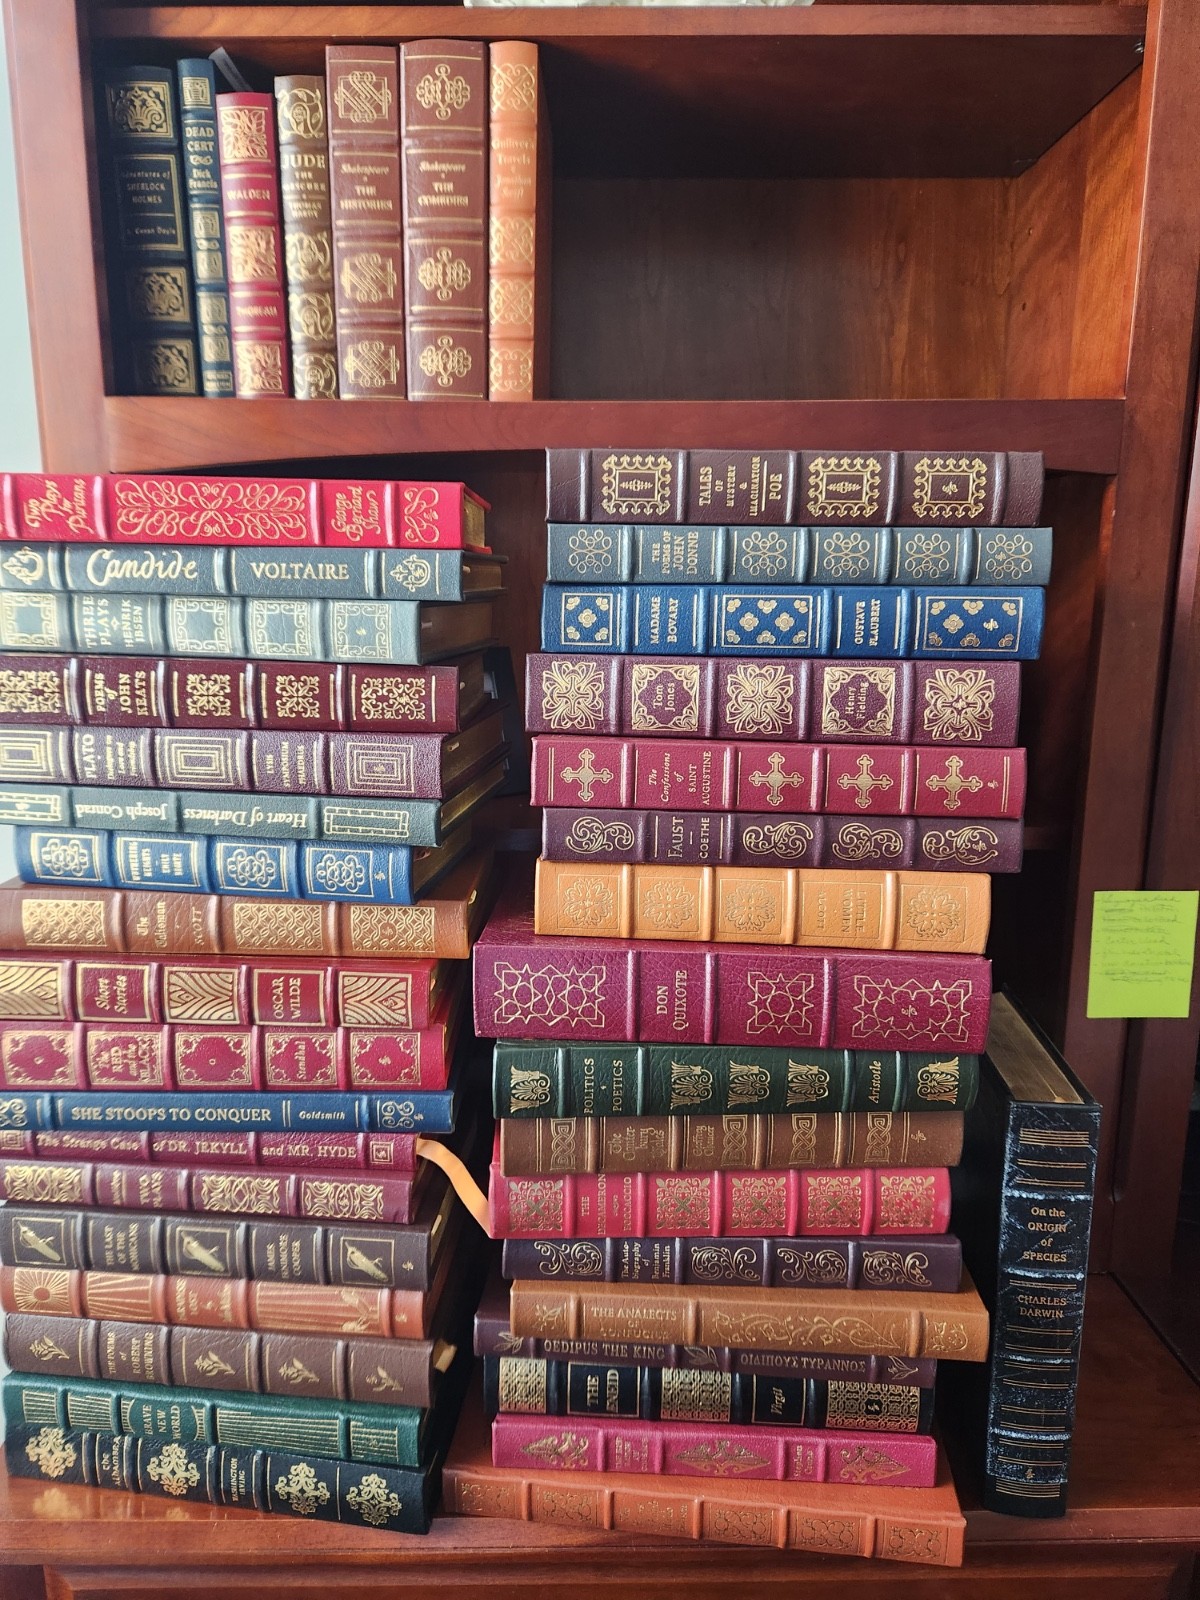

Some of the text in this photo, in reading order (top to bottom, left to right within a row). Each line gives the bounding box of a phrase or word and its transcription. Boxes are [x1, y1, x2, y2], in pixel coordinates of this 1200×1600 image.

[185, 127, 214, 138] DEAD
[187, 141, 214, 152] CERT
[281, 154, 326, 170] JUDE
[340, 163, 390, 176] Shakespeare
[419, 161, 466, 173] Shakespeare
[226, 189, 271, 201] WALDEN
[698, 466, 713, 507] TALES
[714, 479, 724, 492] OF
[726, 465, 737, 507] MYSTERY
[749, 456, 760, 517] IMAGINATION
[768, 472, 783, 501] POE
[86, 548, 198, 586] Candide
[652, 543, 660, 563] THE
[662, 544, 671, 575] POEMS
[673, 535, 684, 571] JOHN
[687, 531, 698, 575] DONNE
[250, 562, 350, 580] VOLTAIRE
[82, 595, 95, 649] THREE
[96, 598, 111, 646] PLAYS
[121, 599, 134, 648] HENRIK
[132, 605, 146, 643] IBSEN
[650, 596, 660, 645] MADAME
[667, 597, 678, 643] BOVARY
[854, 601, 865, 645] GUSTAVE
[869, 598, 880, 647] FLAUBERT
[94, 672, 106, 712] POEMS
[118, 673, 132, 714] JOHN
[135, 670, 148, 716] KEATS
[653, 684, 664, 710] Tom
[664, 682, 675, 712] Jones
[845, 686, 856, 714] Henry
[855, 680, 869, 720] Fielding
[82, 733, 97, 779] PLATO
[281, 741, 290, 788] SYMPOSIUM
[649, 769, 657, 786] The
[661, 752, 671, 802] Confessions
[688, 763, 697, 793] SAINT
[702, 751, 712, 806] AUGUSTINE
[75, 801, 168, 820] Joseph Conrad
[183, 807, 247, 826] Darkness
[266, 812, 307, 829] Heart
[668, 815, 684, 858] FAUST
[699, 817, 710, 859] GOETHE
[841, 889, 853, 934] WOMEN
[94, 977, 112, 1011] Short
[113, 975, 128, 1015] Stories
[272, 976, 285, 1020] OSCAR
[289, 976, 301, 1020] WILDE
[656, 985, 669, 1015] DON
[672, 969, 689, 1031] QUIXOTE
[110, 1046, 123, 1073] RED
[584, 1057, 595, 1114] POLITICS
[612, 1059, 623, 1112] POETICS
[868, 1060, 882, 1104] Aristotle
[72, 1106, 272, 1123] SHE STOOPS TO CONQUER
[299, 1110, 346, 1120] Goldsmith
[168, 1139, 191, 1153] DR.
[194, 1140, 248, 1155] JEKYLL
[262, 1145, 284, 1157] and
[287, 1145, 314, 1158] MR.
[317, 1145, 358, 1159] HYDE
[623, 1176, 632, 1231] BOCCACCIO
[1030, 1206, 1066, 1217] On the
[1028, 1222, 1067, 1233] ORIGIN
[1040, 1237, 1054, 1247] of
[632, 1242, 641, 1280] biography
[652, 1243, 660, 1280] Benjamin
[662, 1244, 671, 1279] Franklin
[1023, 1250, 1067, 1263] SPECIES
[591, 1305, 678, 1321] THE ANALECTS
[1018, 1294, 1068, 1306] CHARLES
[1020, 1307, 1064, 1319] DARWIN
[130, 1337, 141, 1375] ROBERT
[544, 1338, 666, 1361] OEDIPUS THE KING
[587, 1373, 599, 1407] THE
[771, 1386, 786, 1415] Virgil
[142, 1404, 153, 1436] BRAVE
[157, 1409, 167, 1433] NEW
[170, 1404, 181, 1440] WORLD
[238, 1470, 246, 1497] IRVING
